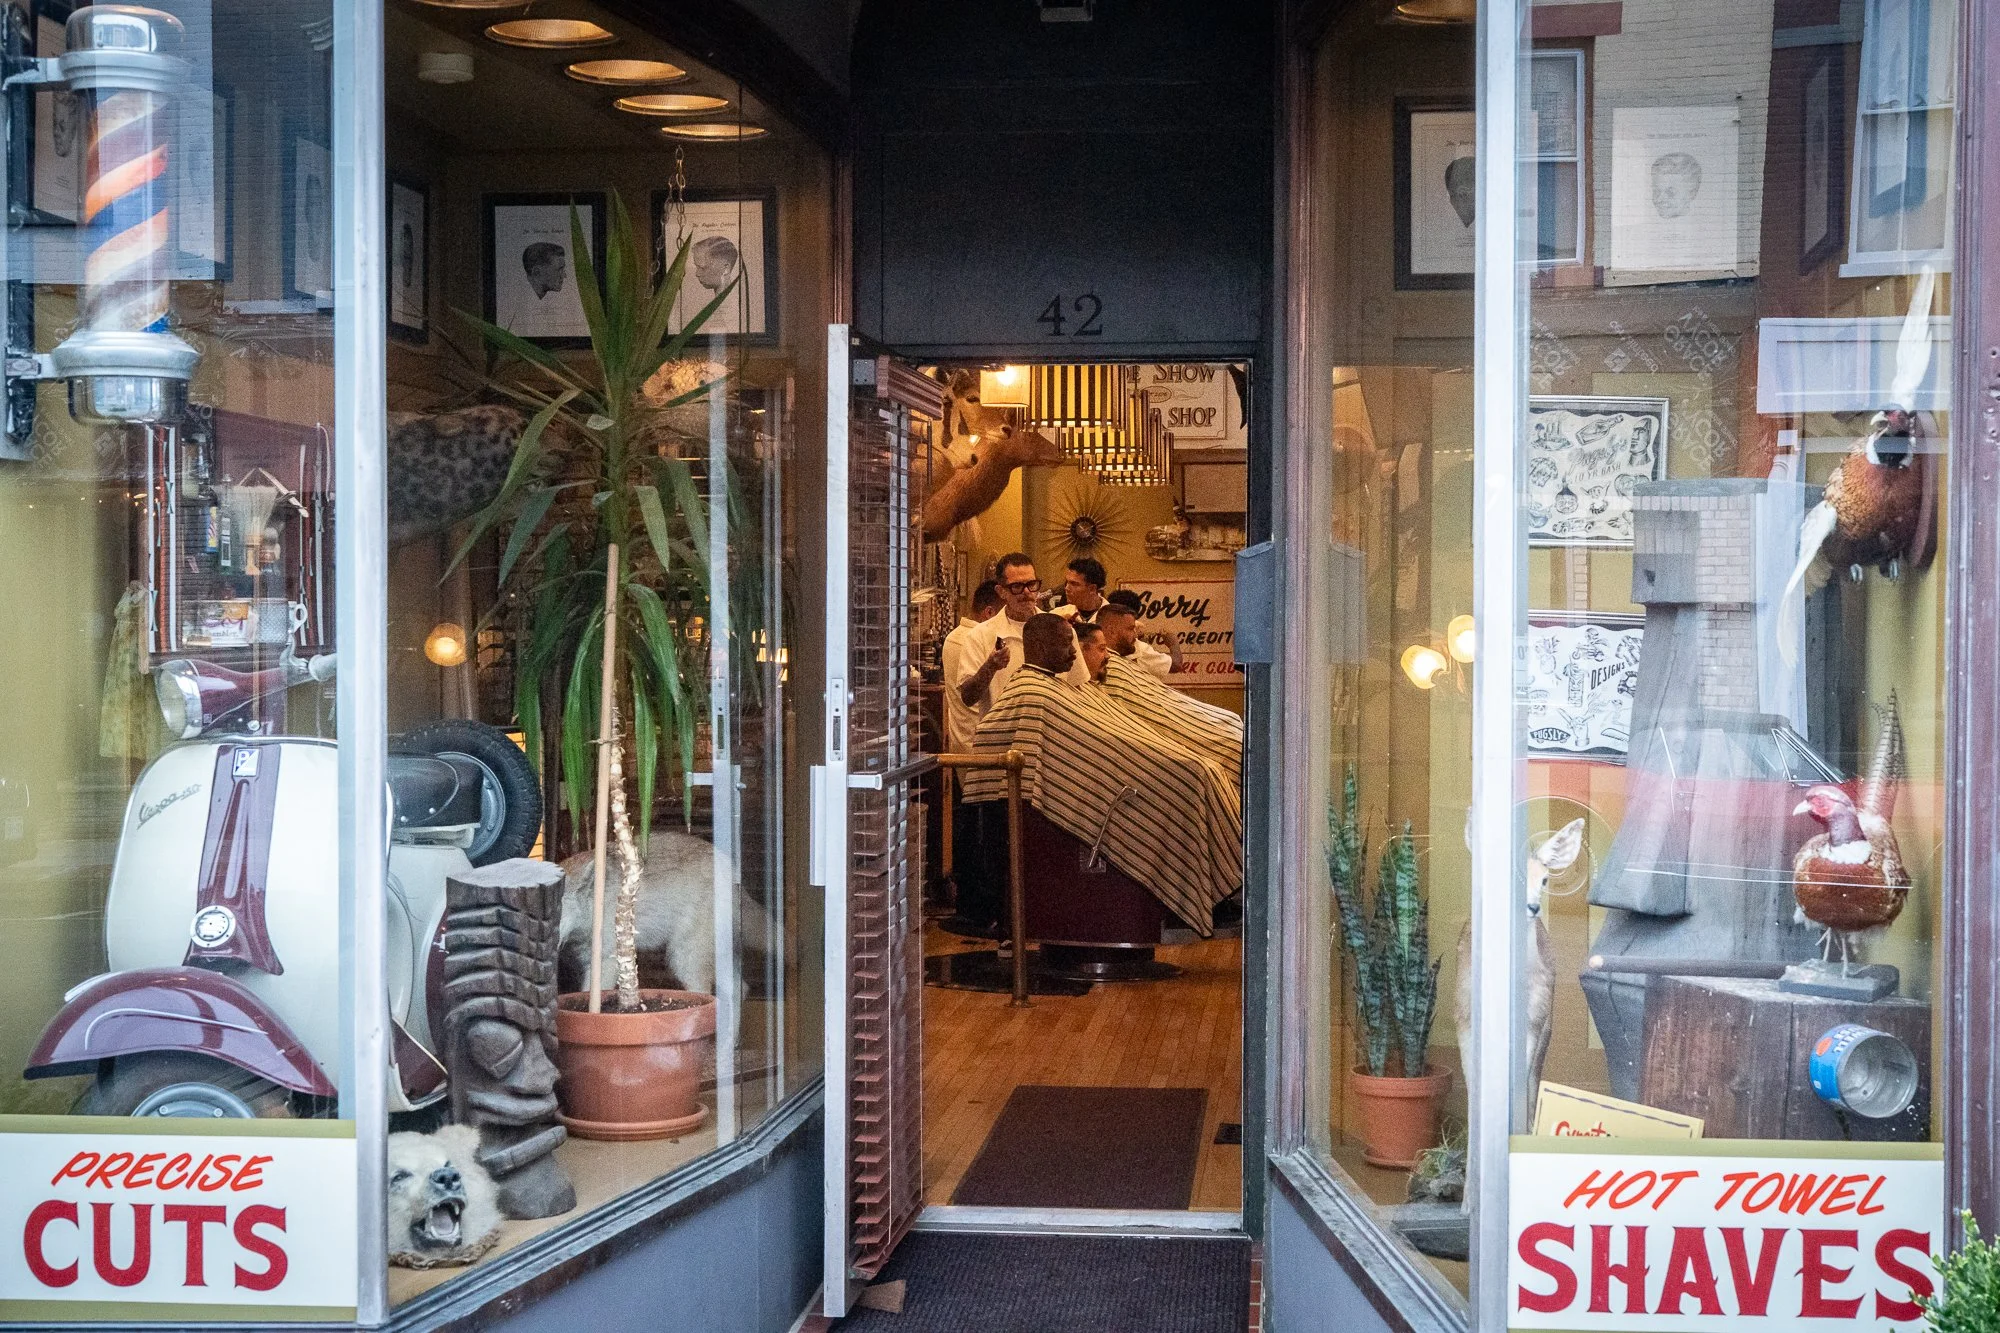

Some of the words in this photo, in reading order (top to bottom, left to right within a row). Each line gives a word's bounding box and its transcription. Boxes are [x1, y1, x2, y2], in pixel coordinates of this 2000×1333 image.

[1036, 293, 1103, 337] 42
[1152, 364, 1216, 384] SHOW
[1168, 406, 1217, 428] SHOP
[1135, 591, 1211, 628] Sorry
[1177, 631, 1234, 645] CREDIT
[51, 1151, 274, 1192] PRECISE
[1563, 1169, 1699, 1211] HOT
[1714, 1171, 1887, 1216] TOWEL
[23, 1199, 289, 1291] CUTS
[1517, 1222, 1935, 1321] SHAVES
